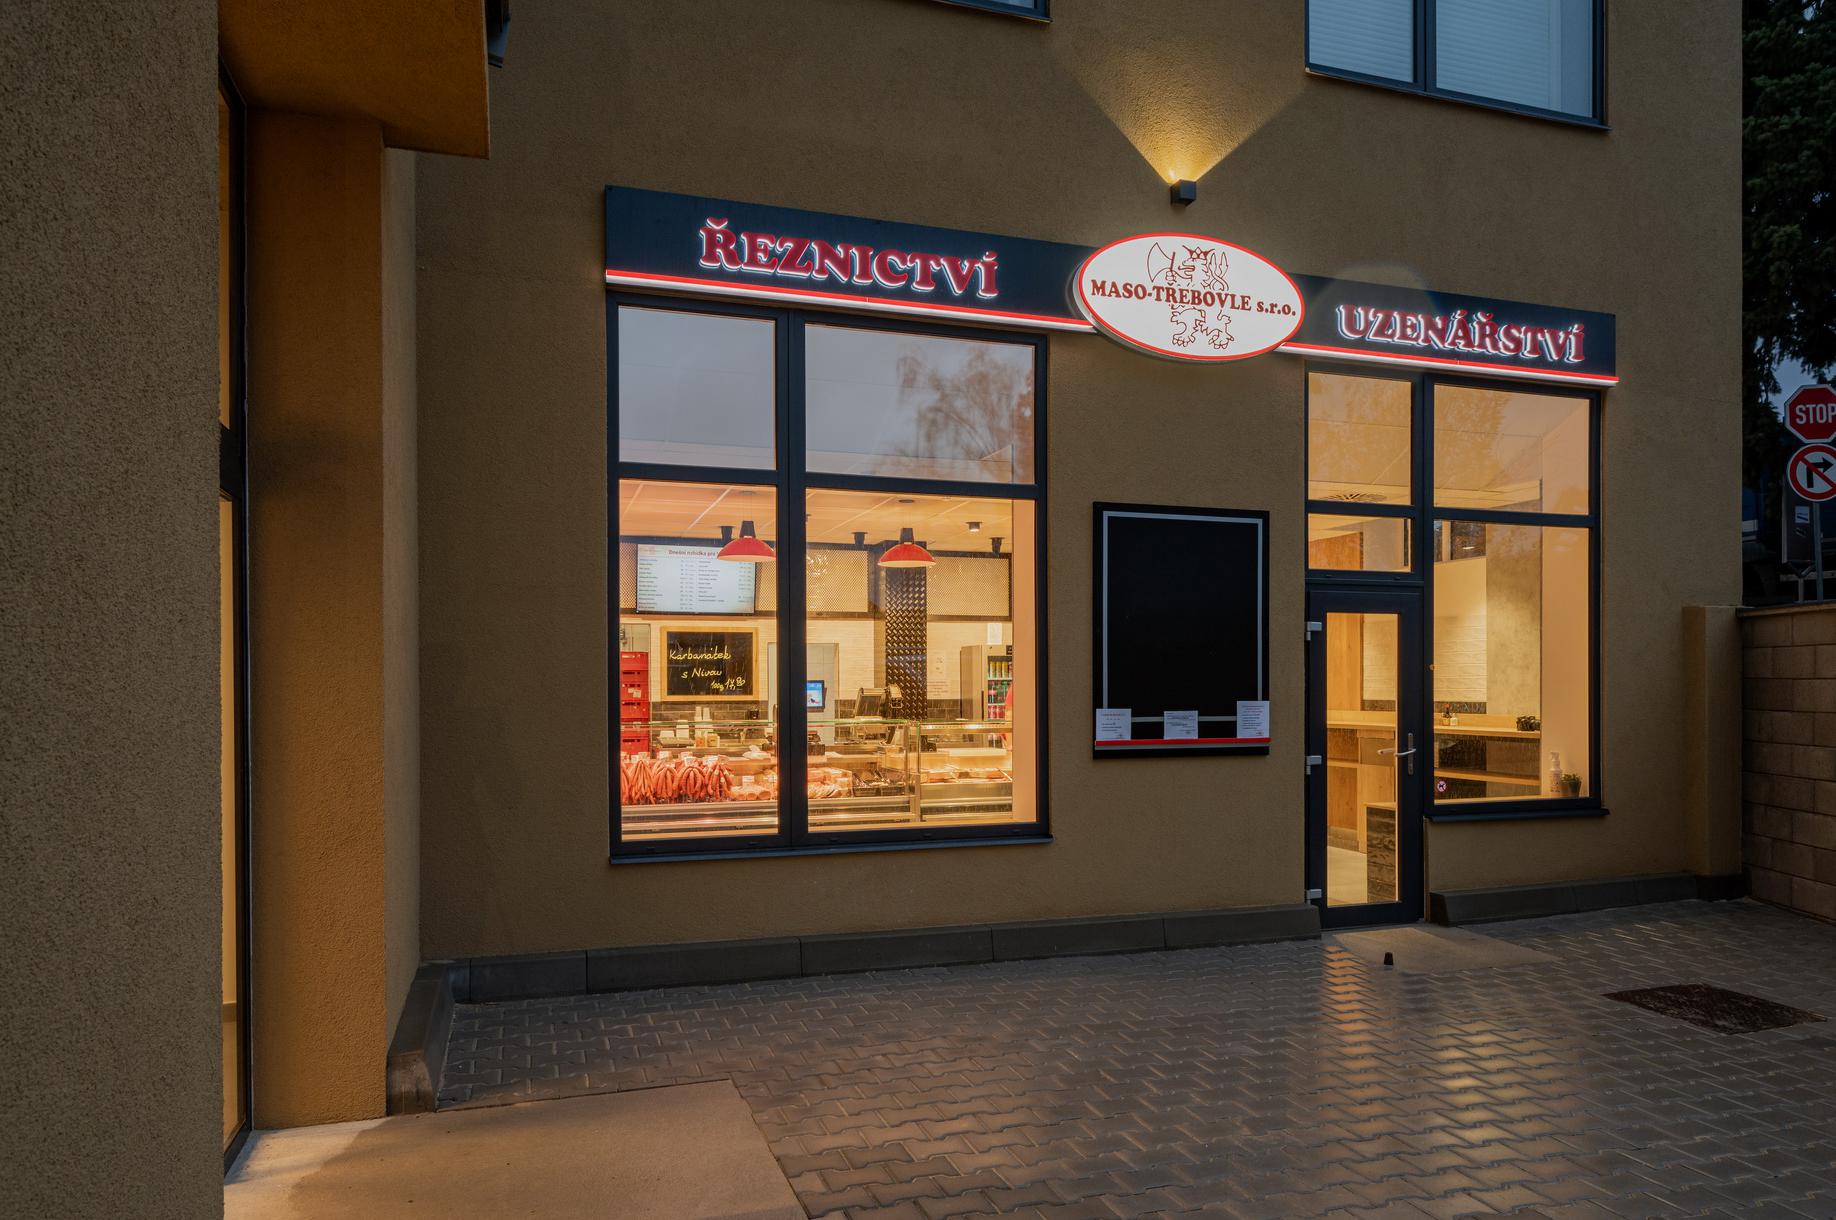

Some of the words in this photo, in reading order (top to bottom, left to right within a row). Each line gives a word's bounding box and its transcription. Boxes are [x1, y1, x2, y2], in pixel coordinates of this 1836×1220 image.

[699, 217, 999, 298] ŘEZNICTVÍ
[1090, 279, 1252, 312] MASO-TŘEBOVLE
[1256, 299, 1297, 317] s.r.o.
[1335, 303, 1586, 363] UZENÁŘSTVÍ
[1795, 403, 1836, 425] STOP
